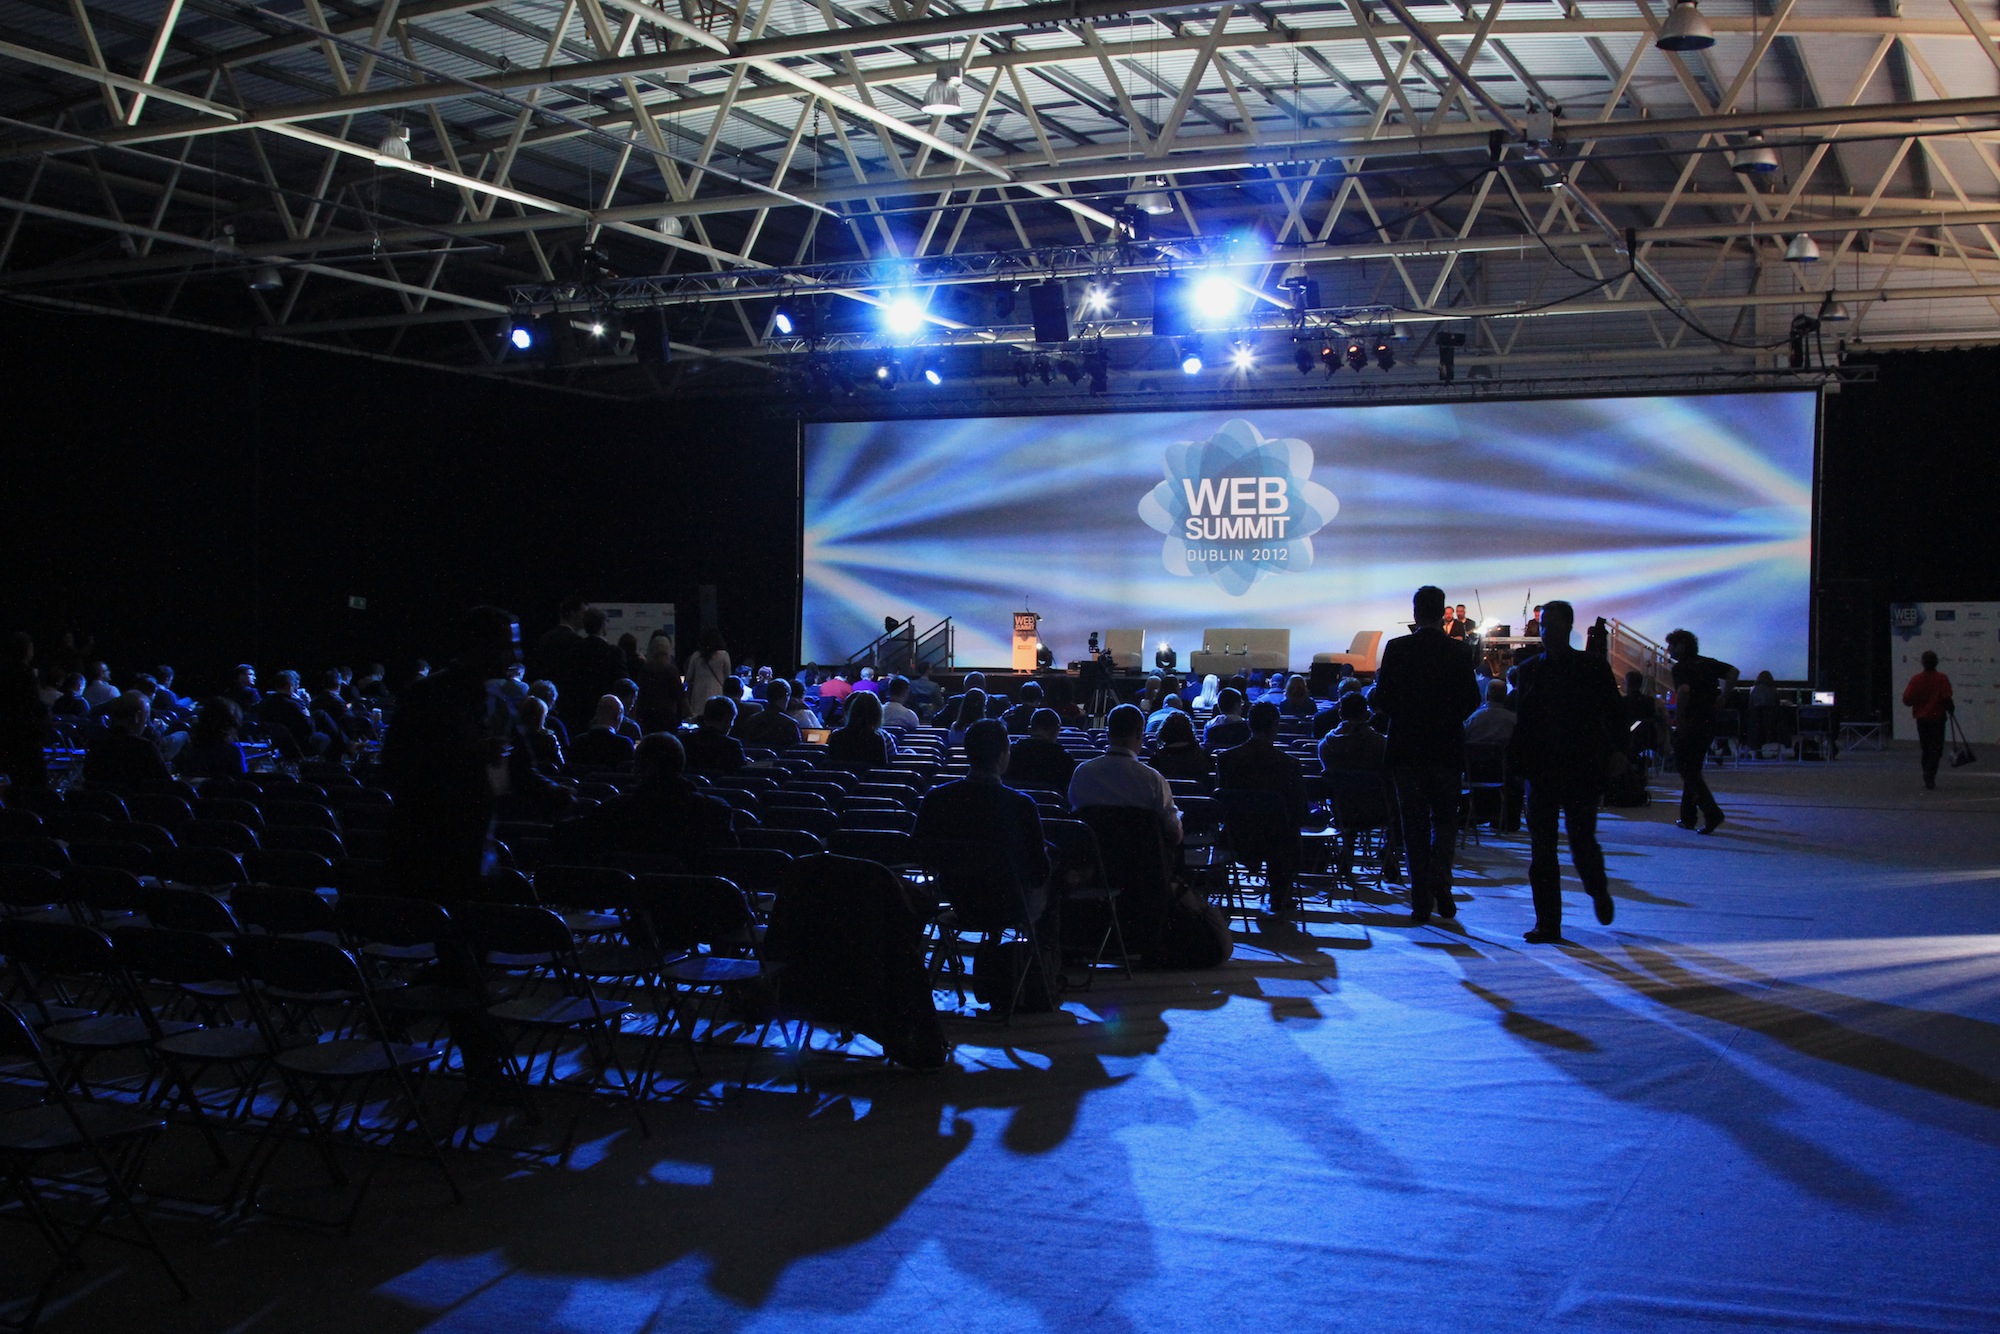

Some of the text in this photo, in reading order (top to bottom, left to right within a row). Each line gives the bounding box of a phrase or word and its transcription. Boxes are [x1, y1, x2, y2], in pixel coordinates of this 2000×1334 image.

[1182, 476, 1289, 516] WEB
[1185, 516, 1291, 540] SUMMIT
[1187, 548, 1288, 562] DUBLIN 2012
[1014, 616, 1035, 625] WEB
[1894, 608, 1917, 619] WEB
